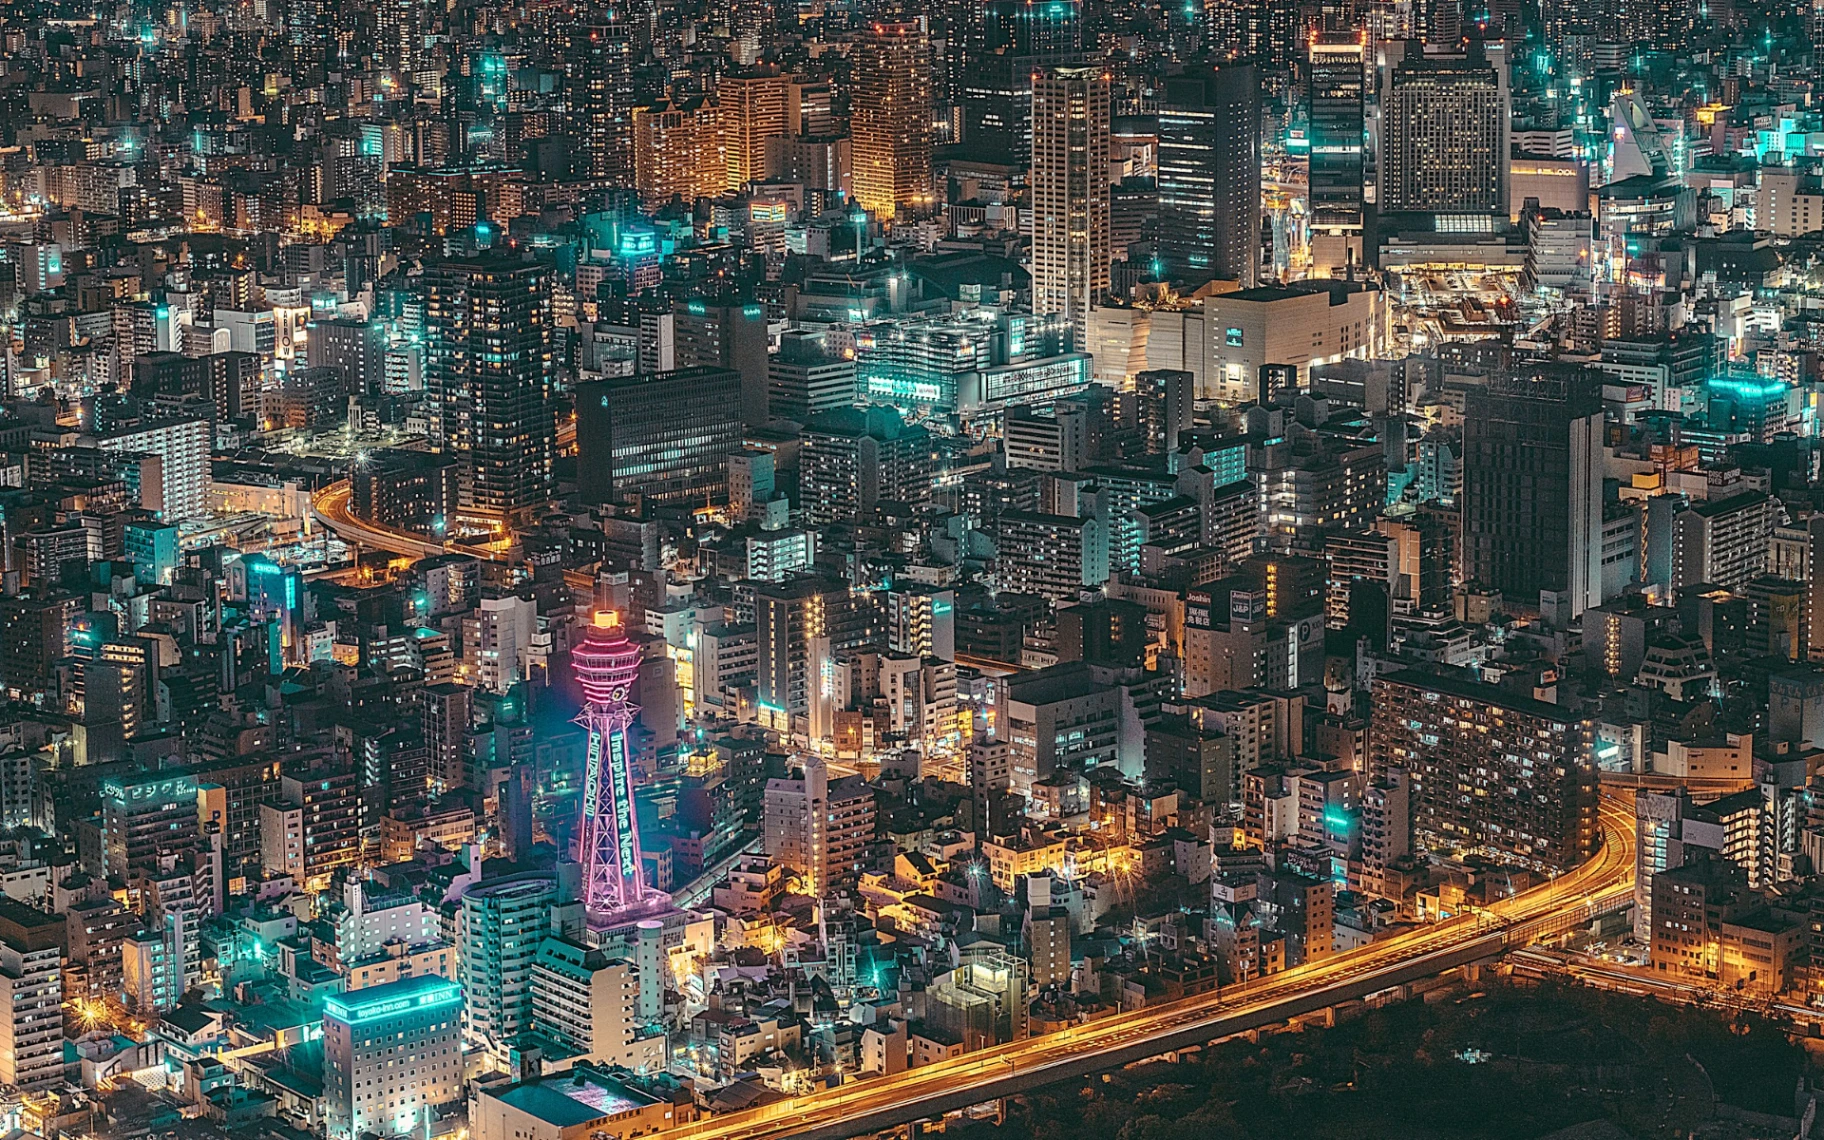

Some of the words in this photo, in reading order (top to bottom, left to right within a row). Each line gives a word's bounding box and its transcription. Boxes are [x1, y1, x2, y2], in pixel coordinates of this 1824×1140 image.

[282, 310, 290, 356] ARROW
[1186, 592, 1211, 604] Joshin
[1233, 604, 1249, 613] J&P
[1188, 606, 1209, 618] TAX-FREE
[585, 732, 601, 817] HITACHI
[611, 731, 627, 797] Inspire
[212, 810, 221, 821] P
[616, 799, 630, 830] the
[619, 830, 633, 876] Next
[357, 999, 411, 1018] toyoko-inn.com
